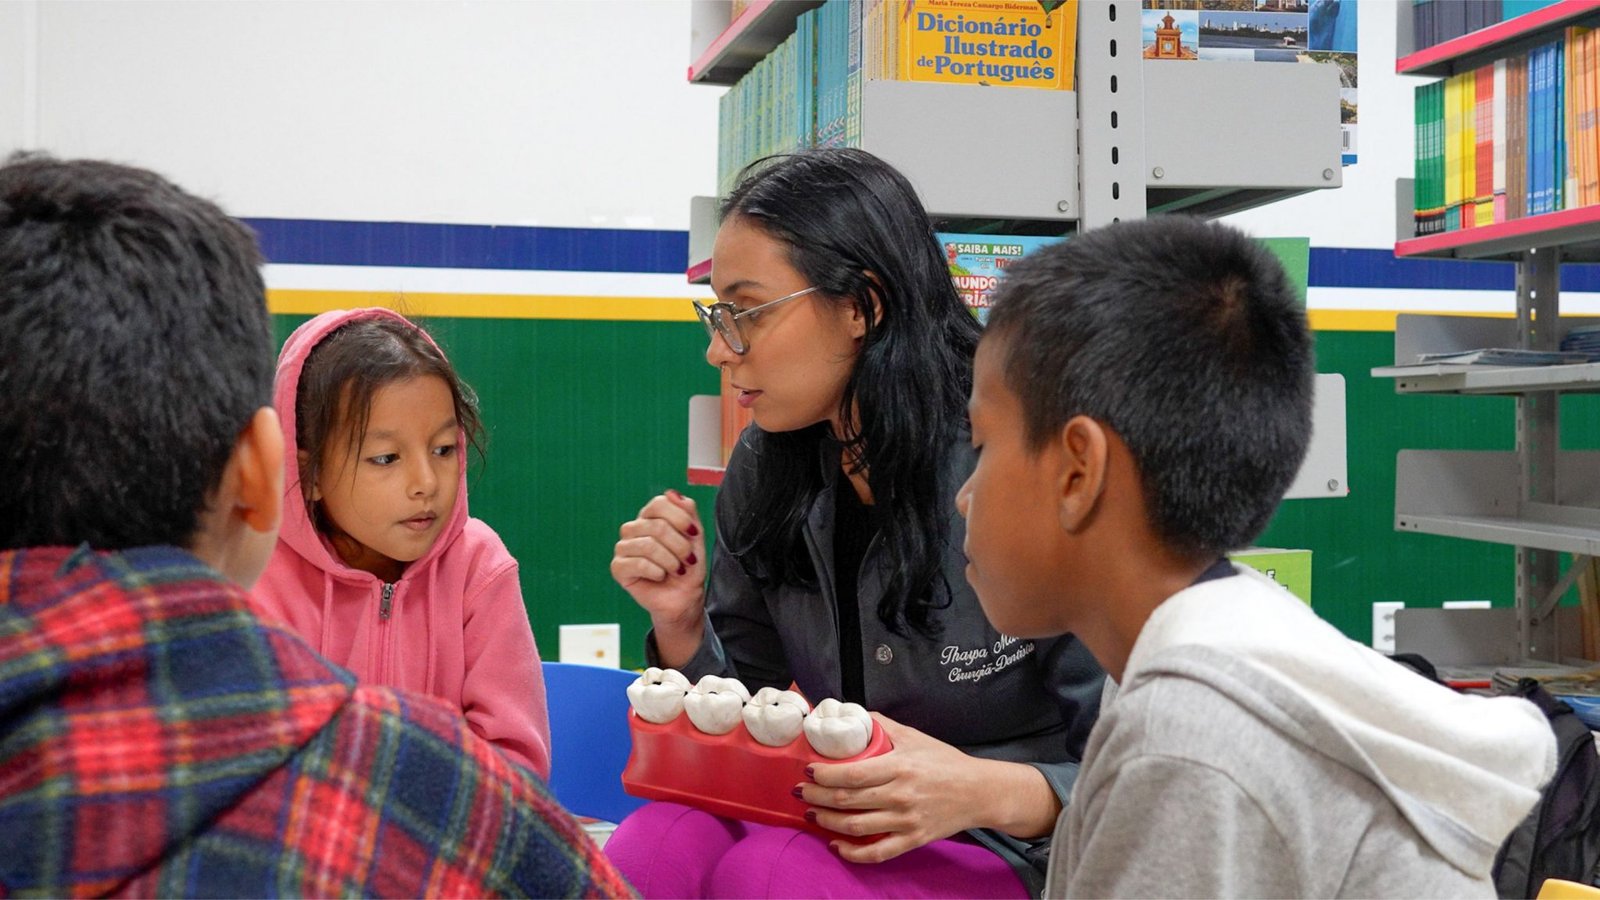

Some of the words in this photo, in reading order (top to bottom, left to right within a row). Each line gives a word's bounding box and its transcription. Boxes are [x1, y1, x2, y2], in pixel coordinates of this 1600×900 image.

[972, 2, 1004, 10] Camargo
[1004, 3, 1038, 11] Biderman
[917, 12, 1042, 37] Dicionário
[944, 35, 1053, 60] Ilustrado
[917, 56, 934, 67] de
[934, 55, 1055, 82] Português
[958, 244, 989, 254] SAIBA
[992, 245, 1022, 256] MAIS!
